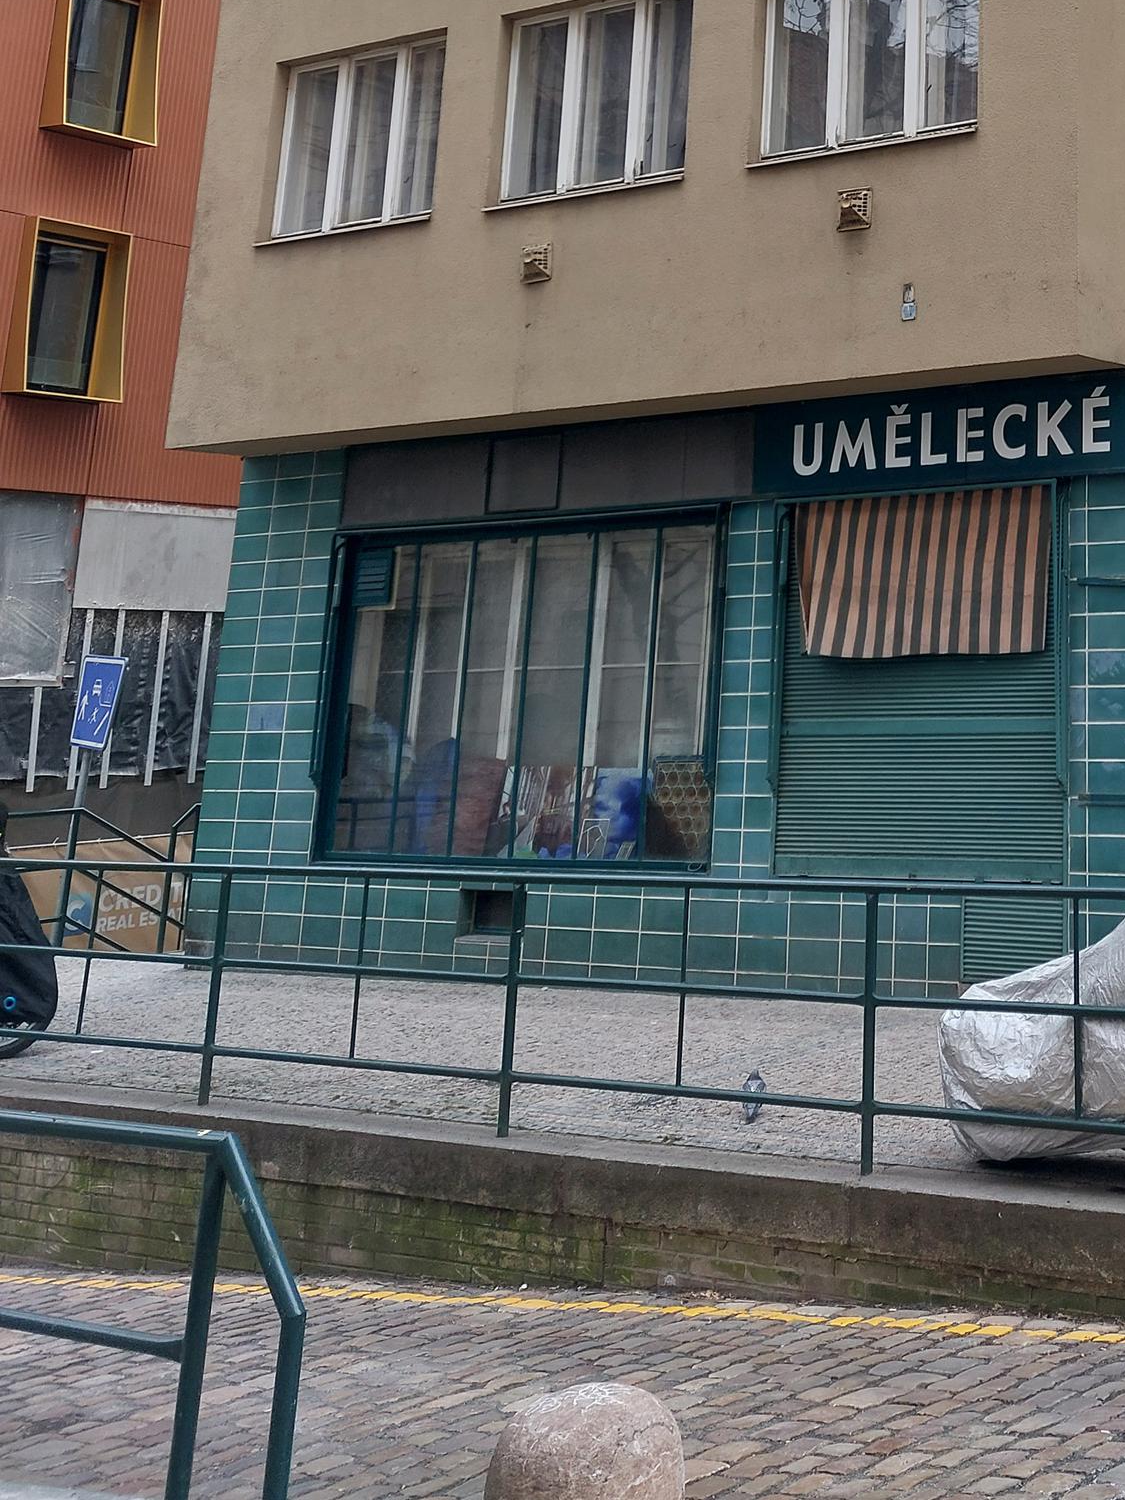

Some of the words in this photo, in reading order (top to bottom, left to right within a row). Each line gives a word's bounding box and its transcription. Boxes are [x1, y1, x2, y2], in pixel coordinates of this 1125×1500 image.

[793, 386, 1111, 476] UMĚLECKÉ
[100, 883, 183, 912] CREDT
[95, 914, 135, 933] REAL
